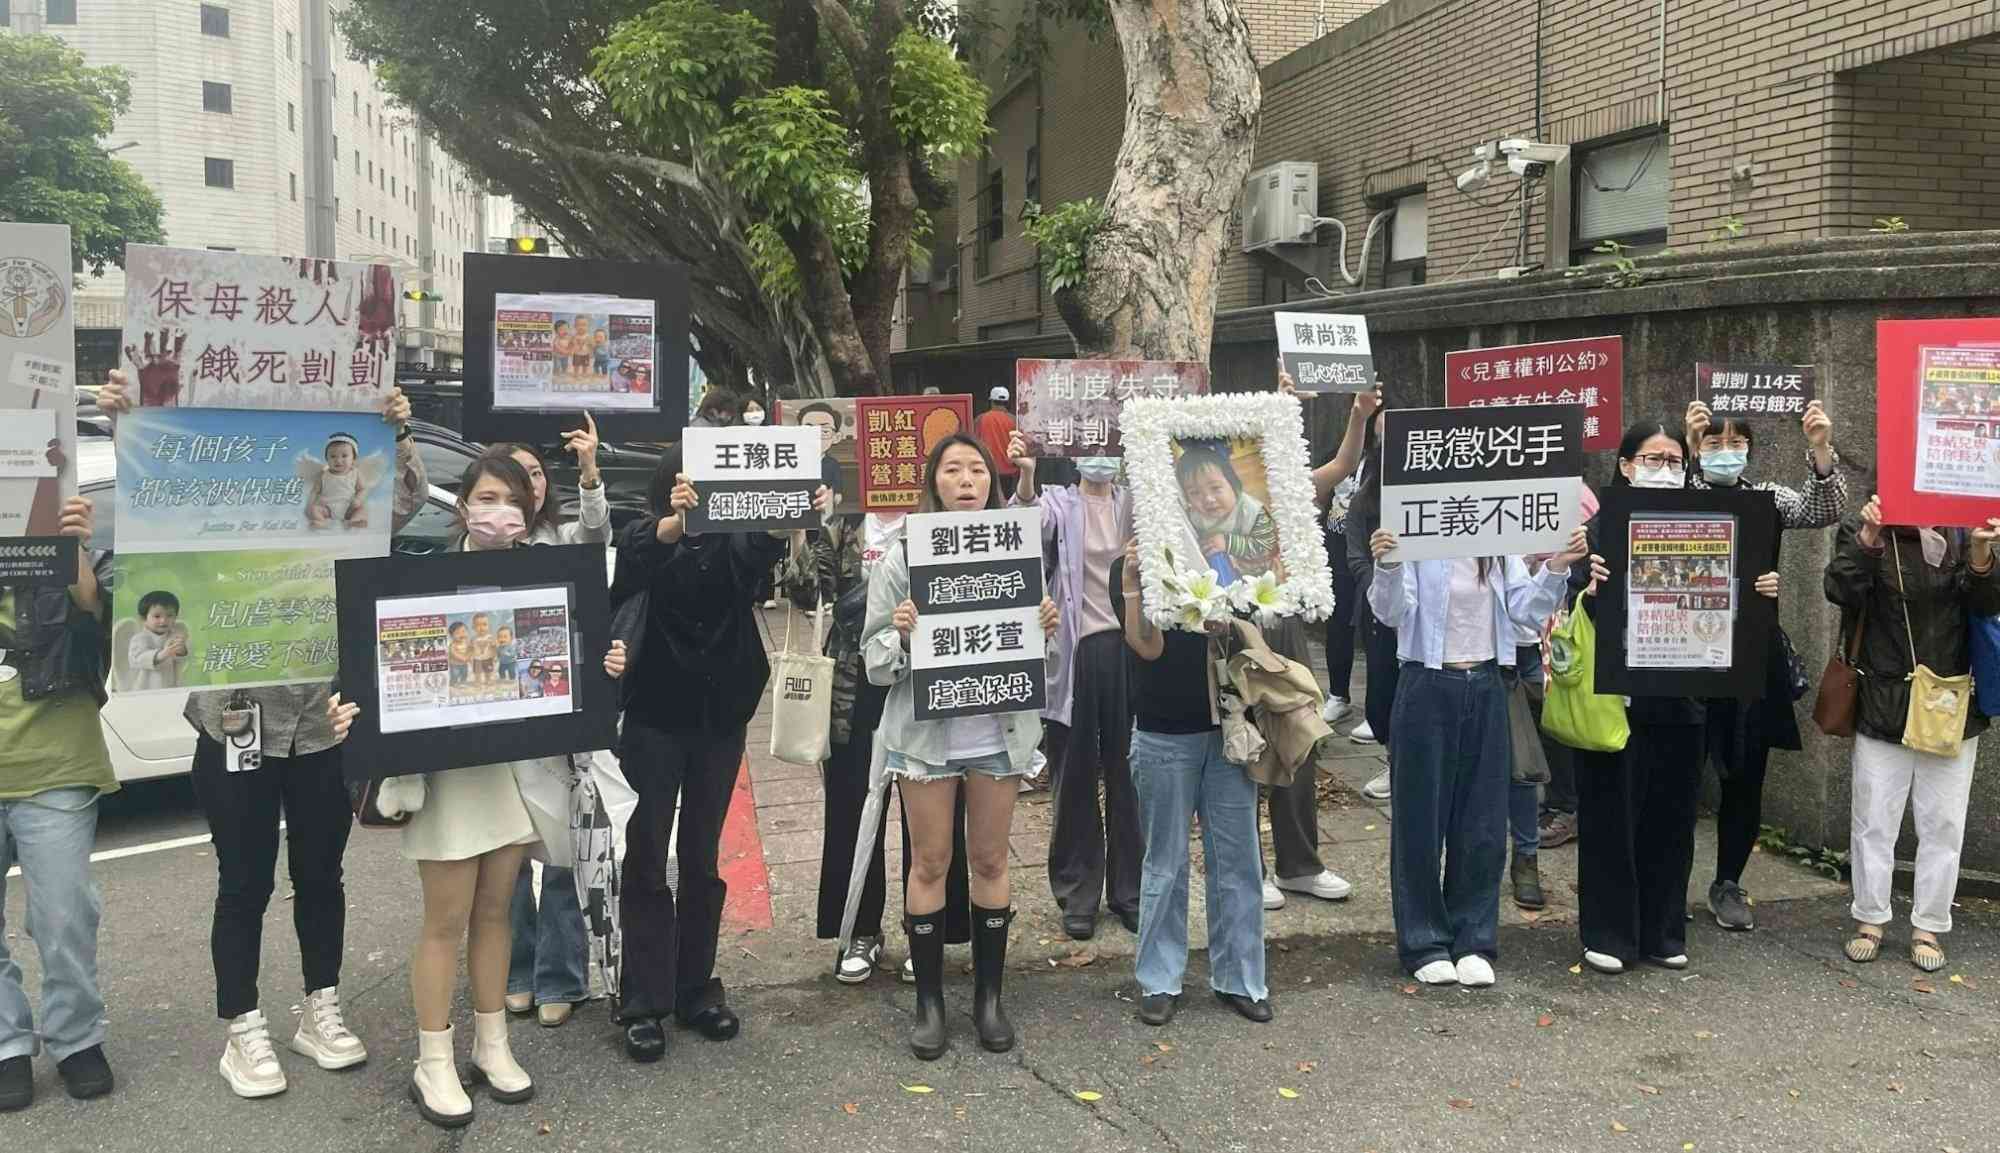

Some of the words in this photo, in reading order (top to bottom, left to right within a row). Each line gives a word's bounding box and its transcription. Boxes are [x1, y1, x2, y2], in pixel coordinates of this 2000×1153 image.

[150, 277, 347, 327] 保母殺人
[1294, 322, 1359, 346] 陳尚潔
[195, 343, 384, 389] 餓死剴剴
[1460, 350, 1609, 382] 《兒童權利公約》
[1047, 372, 1180, 401] 制度失守
[1752, 374, 1803, 391] 114天
[1711, 393, 1805, 413] 被保母餓死
[867, 409, 916, 433] 凱紅
[153, 433, 289, 464] 每個孩子
[714, 442, 798, 470] 王豫民
[868, 435, 918, 460] 敢蓋
[1402, 424, 1566, 472] 嚴懲兇手
[131, 478, 305, 506] 都該被保護
[708, 490, 812, 521] 綑綁高手
[1398, 492, 1560, 537] 正義不眠
[931, 521, 1023, 556] 劉若琳
[928, 571, 1026, 605] 虐童高手
[205, 596, 336, 629] 兒虐零容
[931, 621, 1025, 657] 劉彩萱
[928, 673, 1032, 710] 虐童保母
